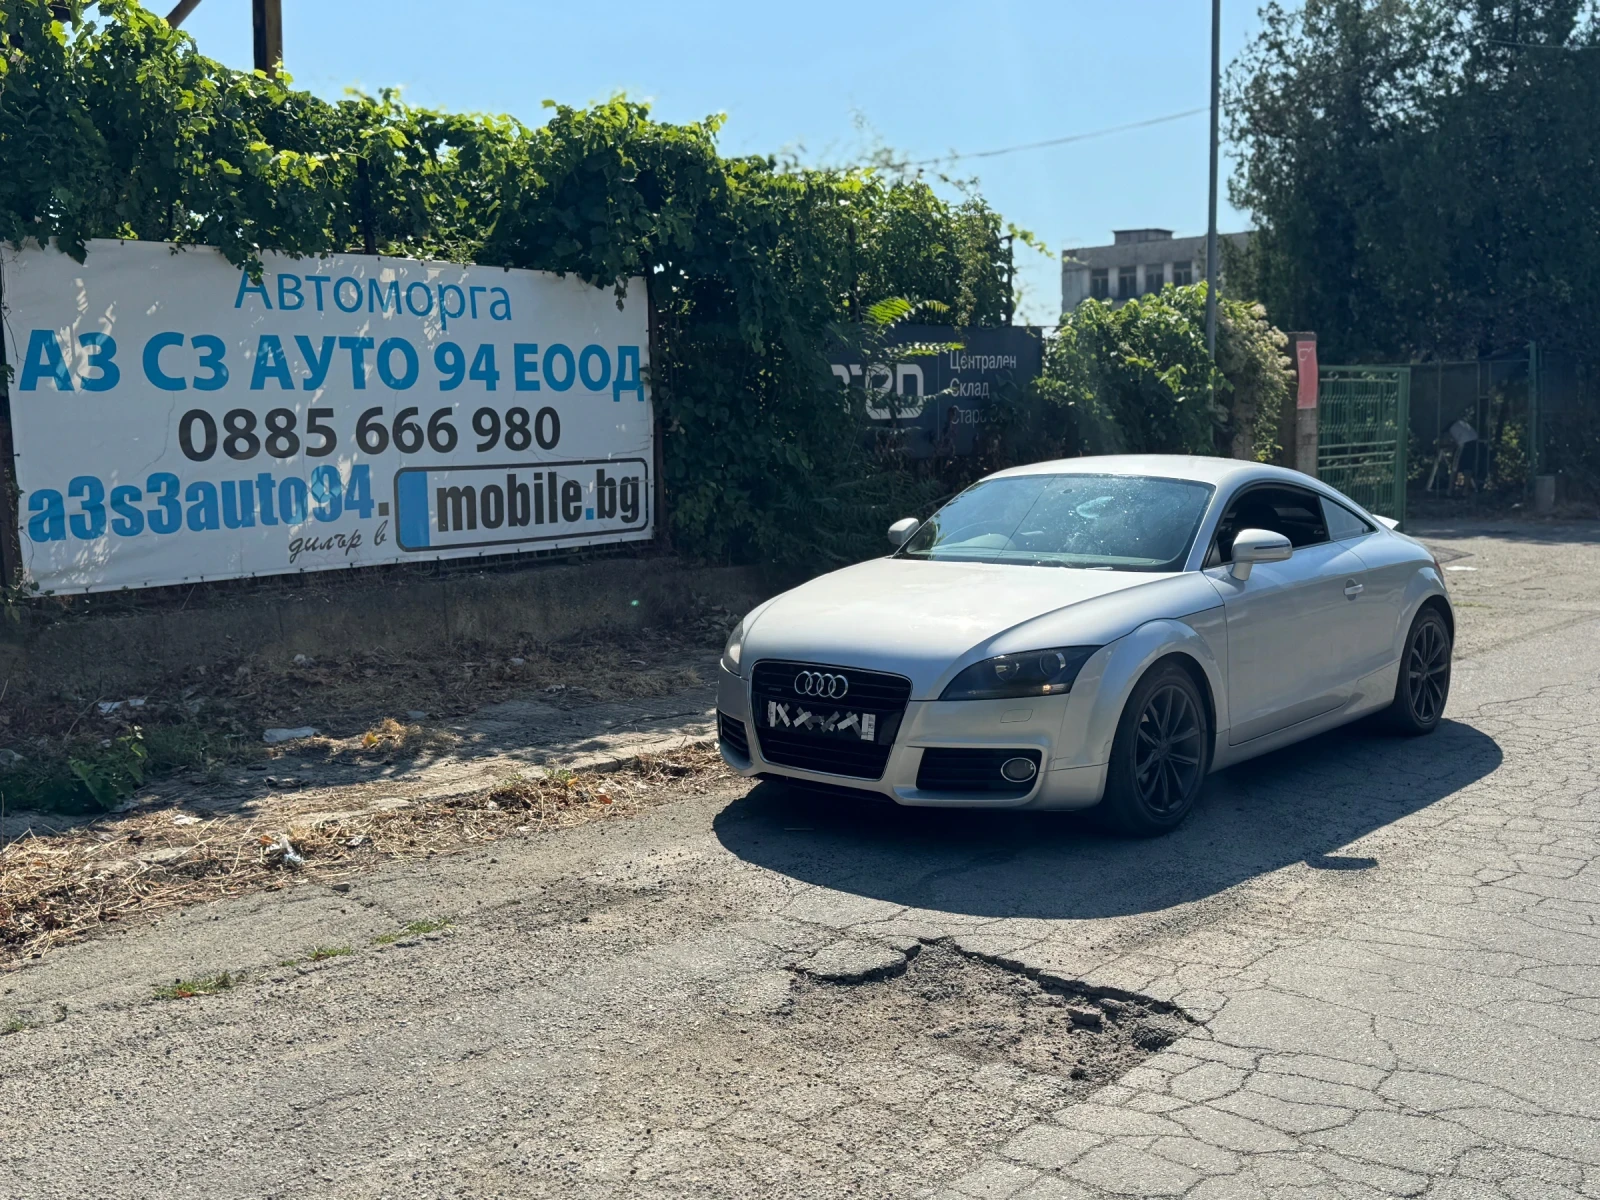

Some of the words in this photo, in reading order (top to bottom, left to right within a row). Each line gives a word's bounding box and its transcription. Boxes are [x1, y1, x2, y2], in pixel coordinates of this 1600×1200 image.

[234, 267, 512, 330] Автоморга
[250, 334, 419, 392] АУТО
[433, 341, 500, 392] 94
[513, 343, 645, 402] ЕООД
[950, 351, 1017, 373] Централен
[950, 377, 990, 399] Склад
[178, 408, 338, 462] 0885
[355, 406, 459, 455] 666
[471, 406, 561, 453] 980
[436, 469, 640, 533] mobile.bg
[288, 530, 364, 564] дилър
